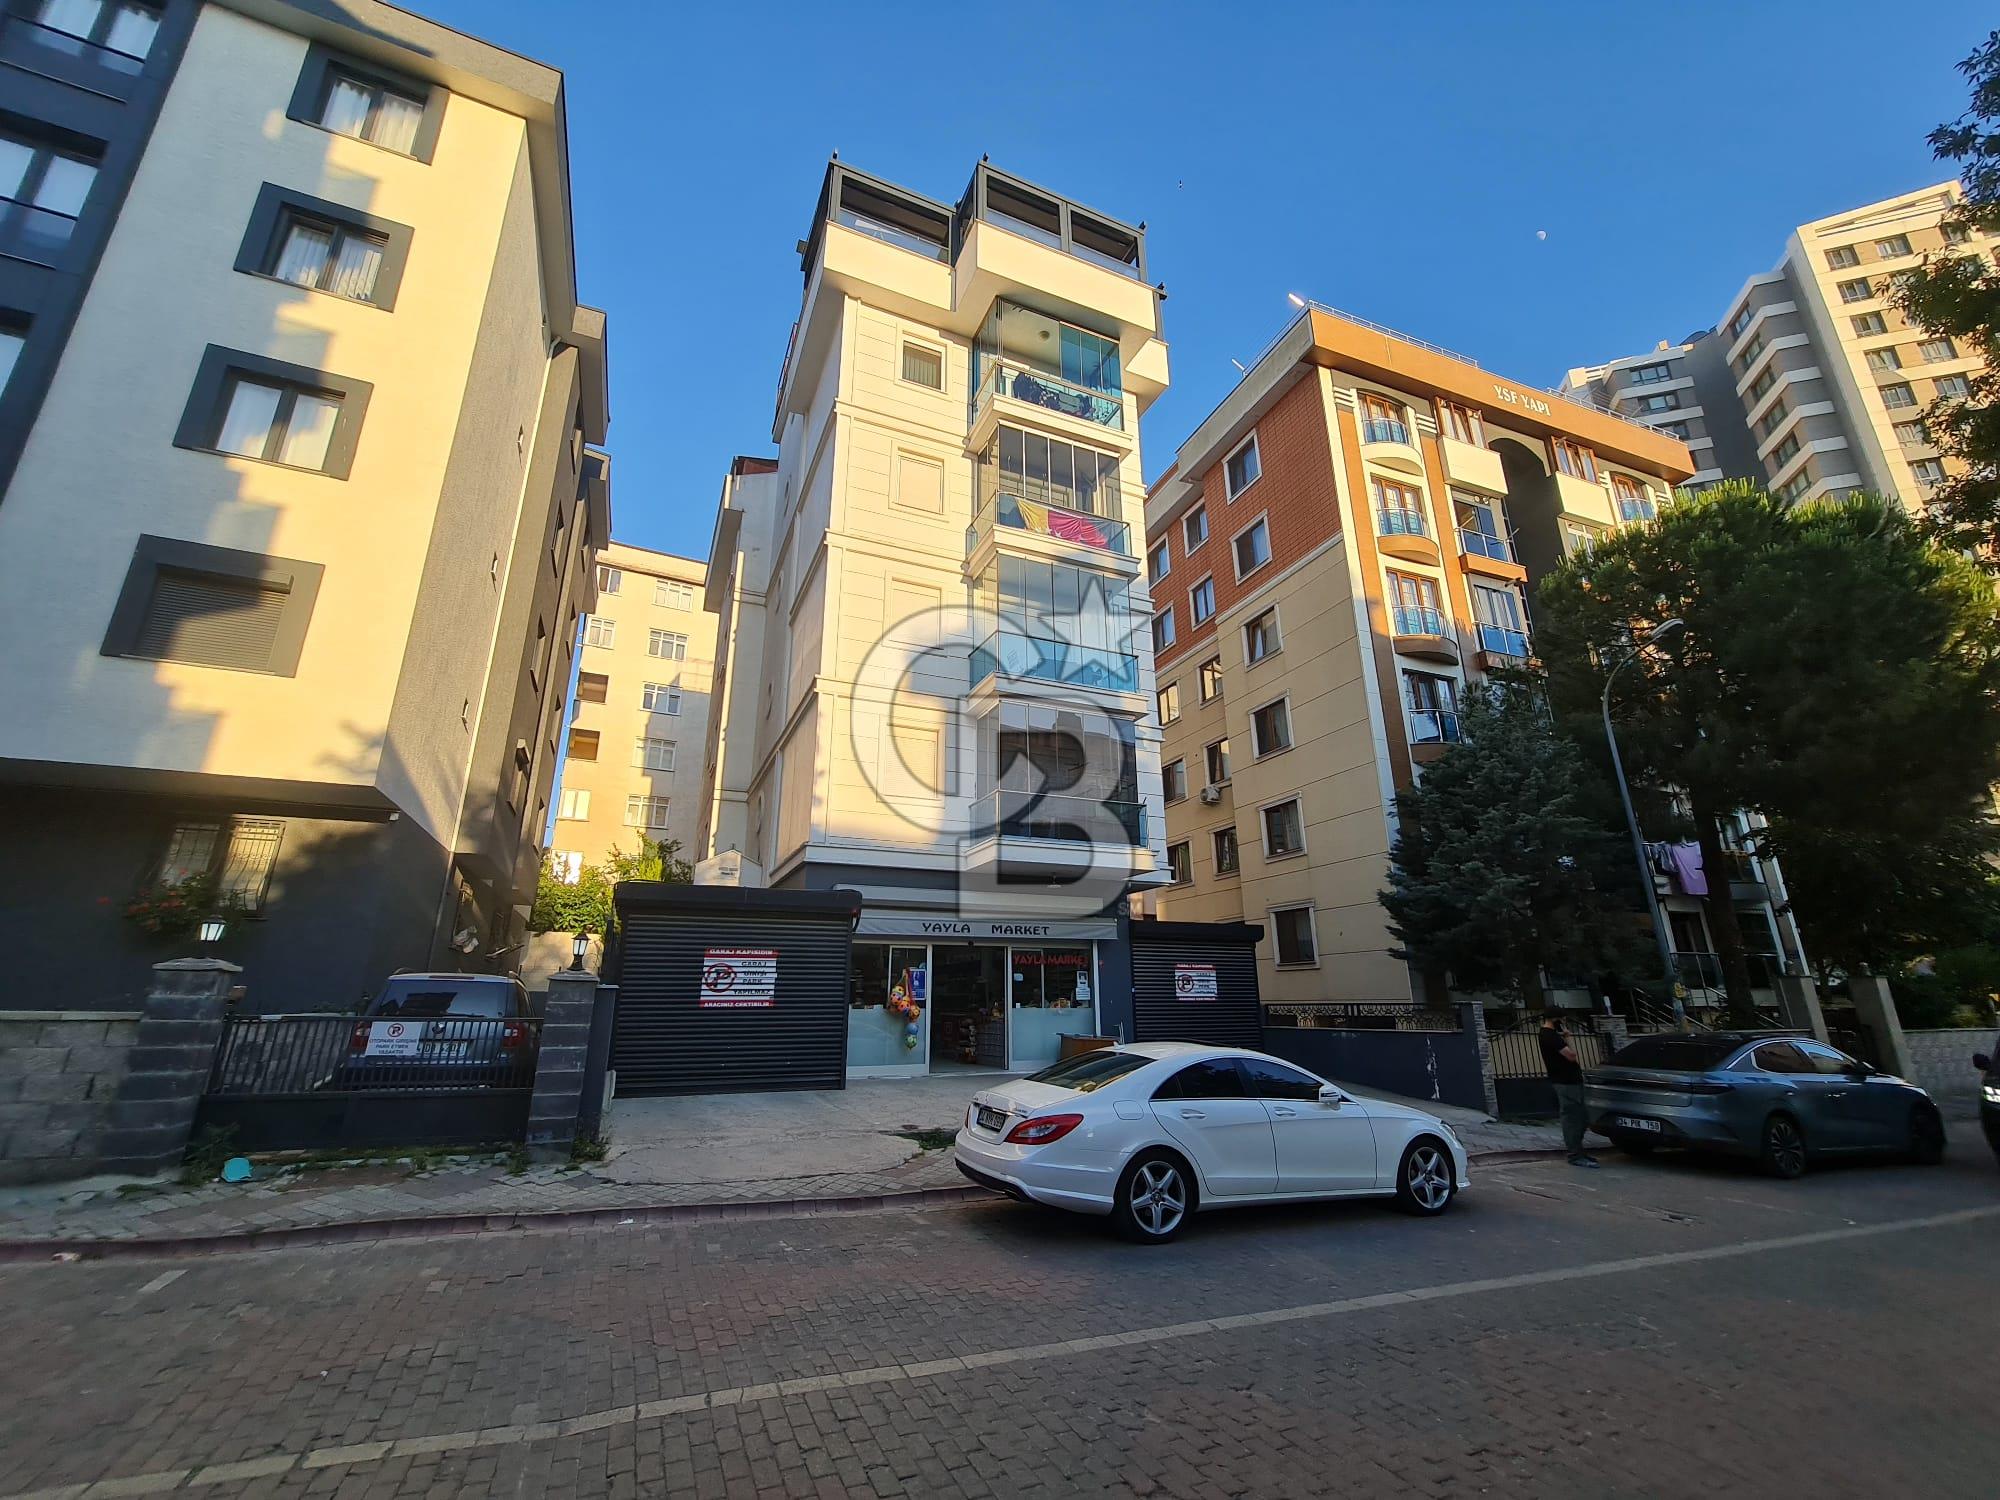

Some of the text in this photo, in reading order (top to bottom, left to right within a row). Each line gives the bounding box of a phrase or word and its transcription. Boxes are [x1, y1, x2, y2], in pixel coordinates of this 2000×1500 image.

[1494, 385, 1551, 416] YSF YAPI
[922, 922, 1050, 935] YAYLA MARKET
[1014, 954, 1046, 966] YAYLA
